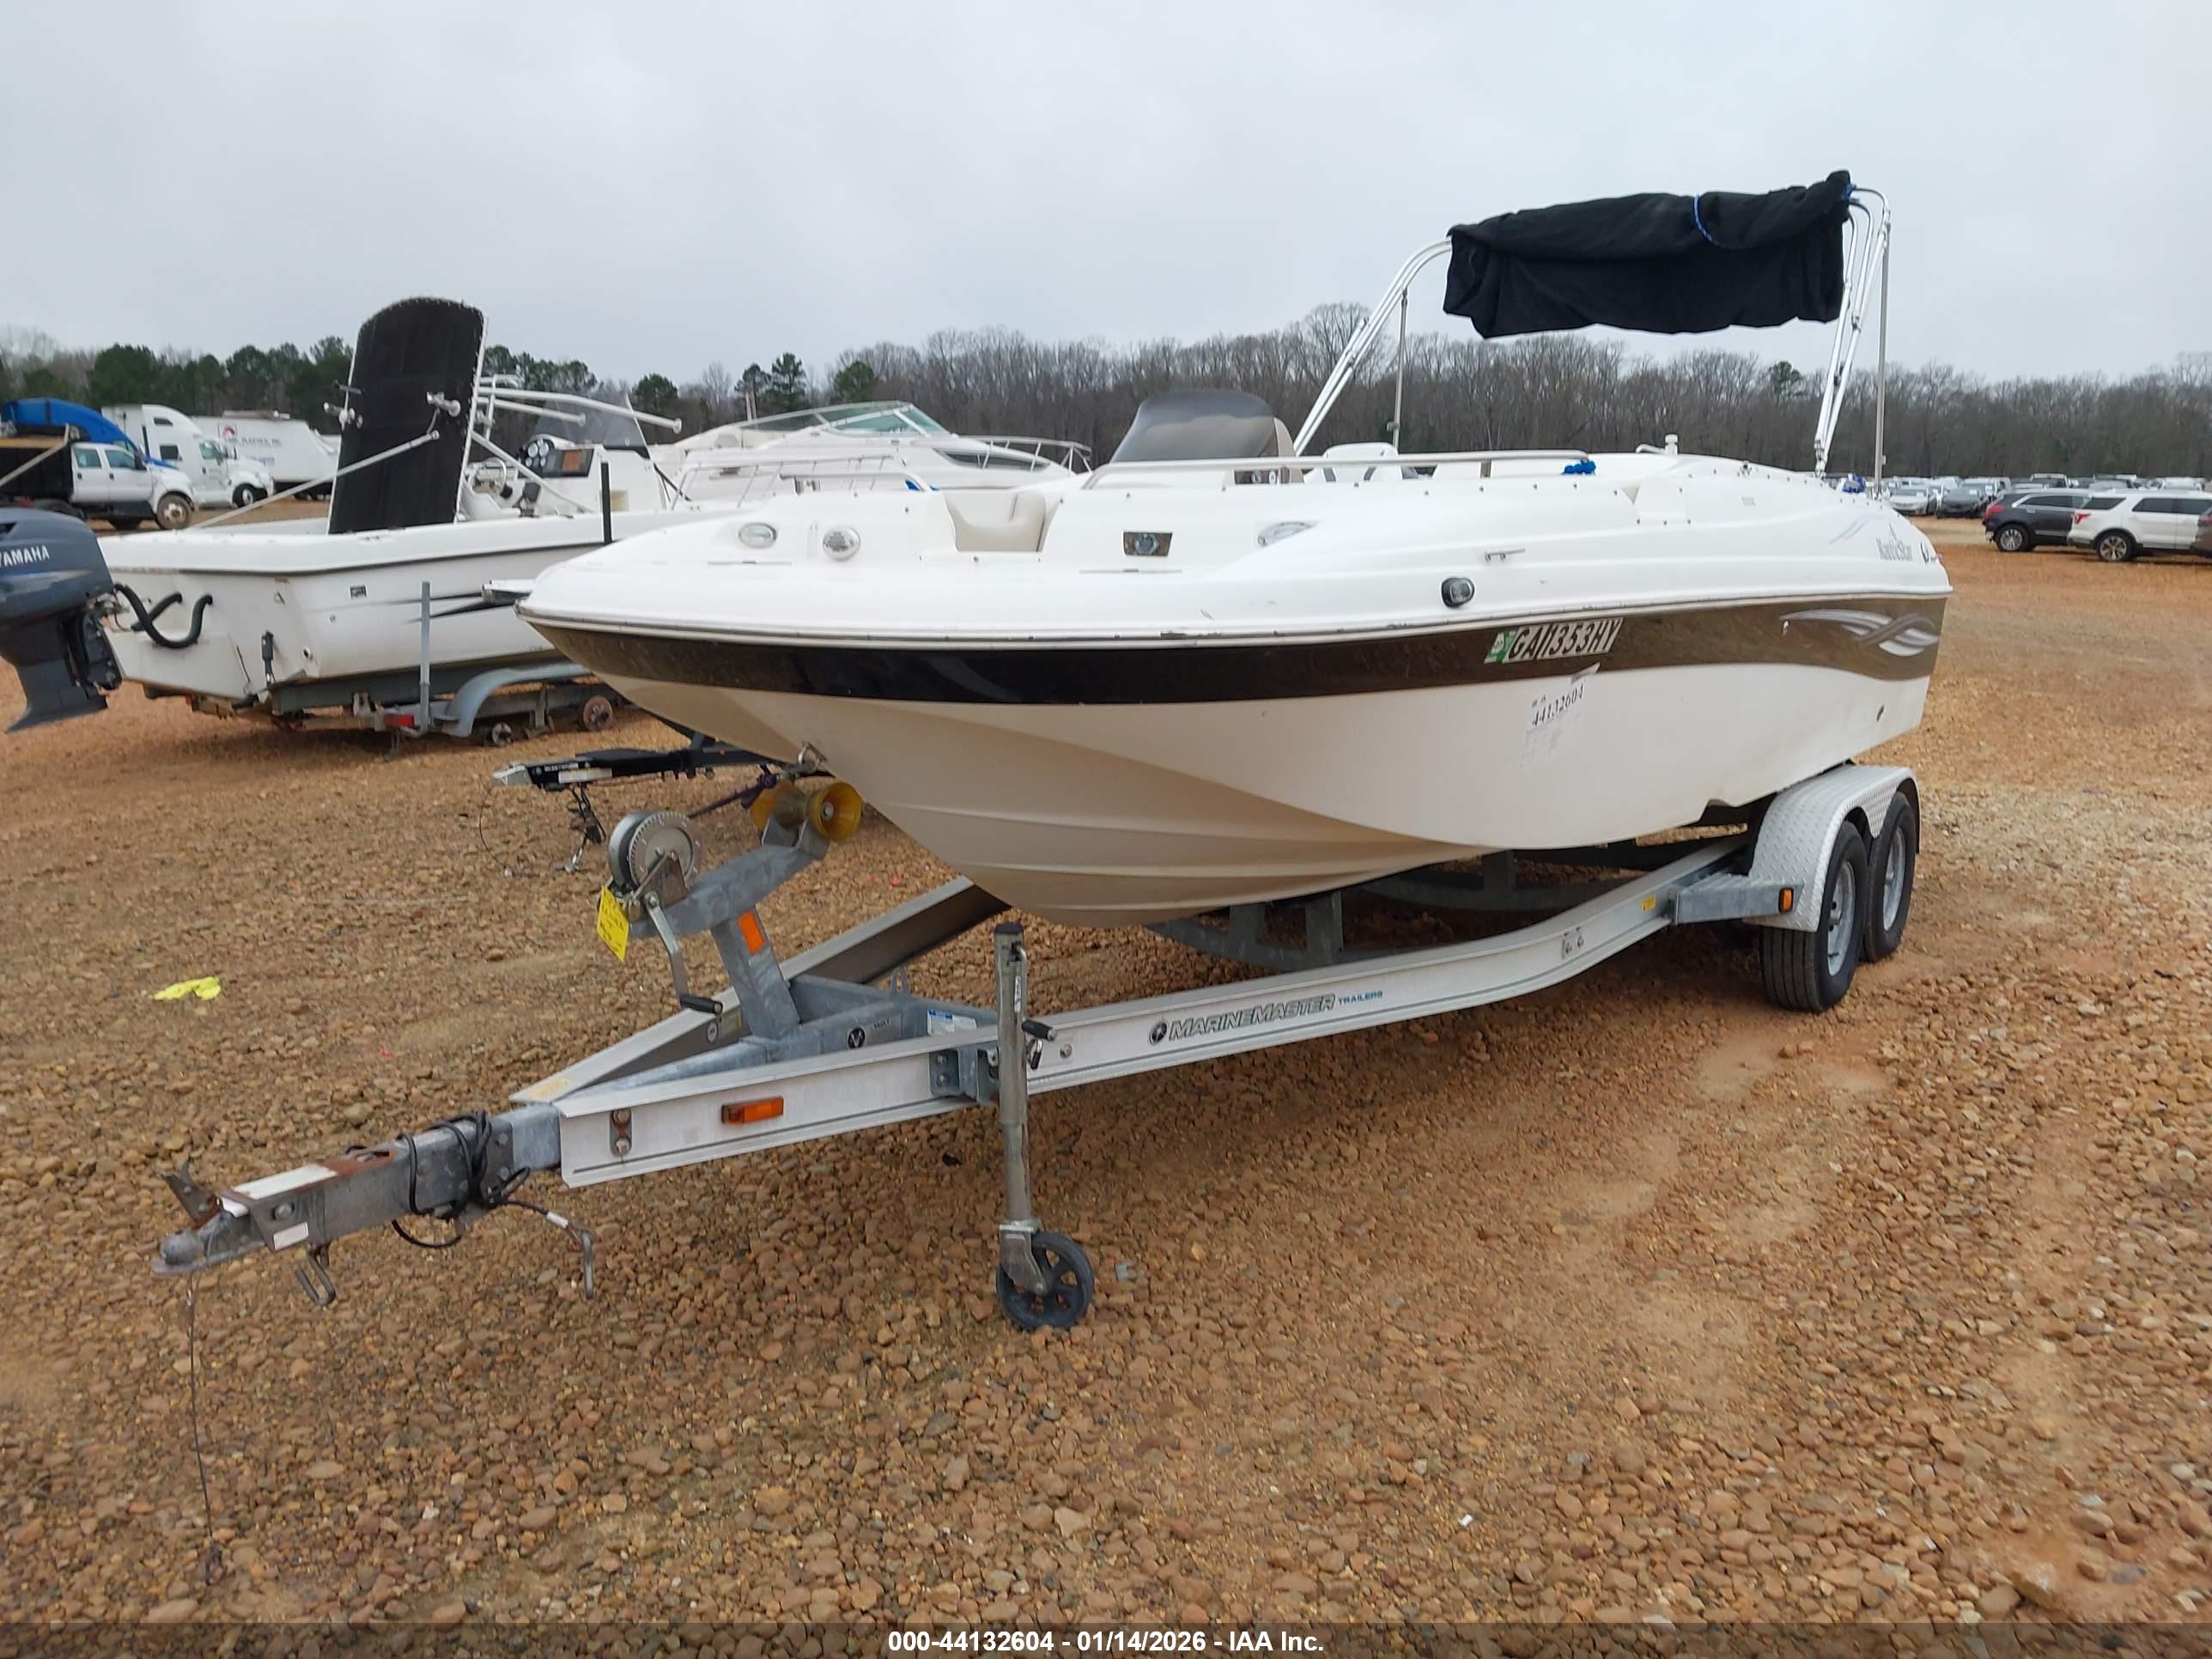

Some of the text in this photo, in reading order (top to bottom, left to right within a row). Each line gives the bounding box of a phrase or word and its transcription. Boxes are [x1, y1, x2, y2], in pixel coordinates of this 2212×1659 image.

[0, 544, 51, 568] AMAHA
[1168, 990, 1383, 1041] MARINEMASTER TRAILERS
